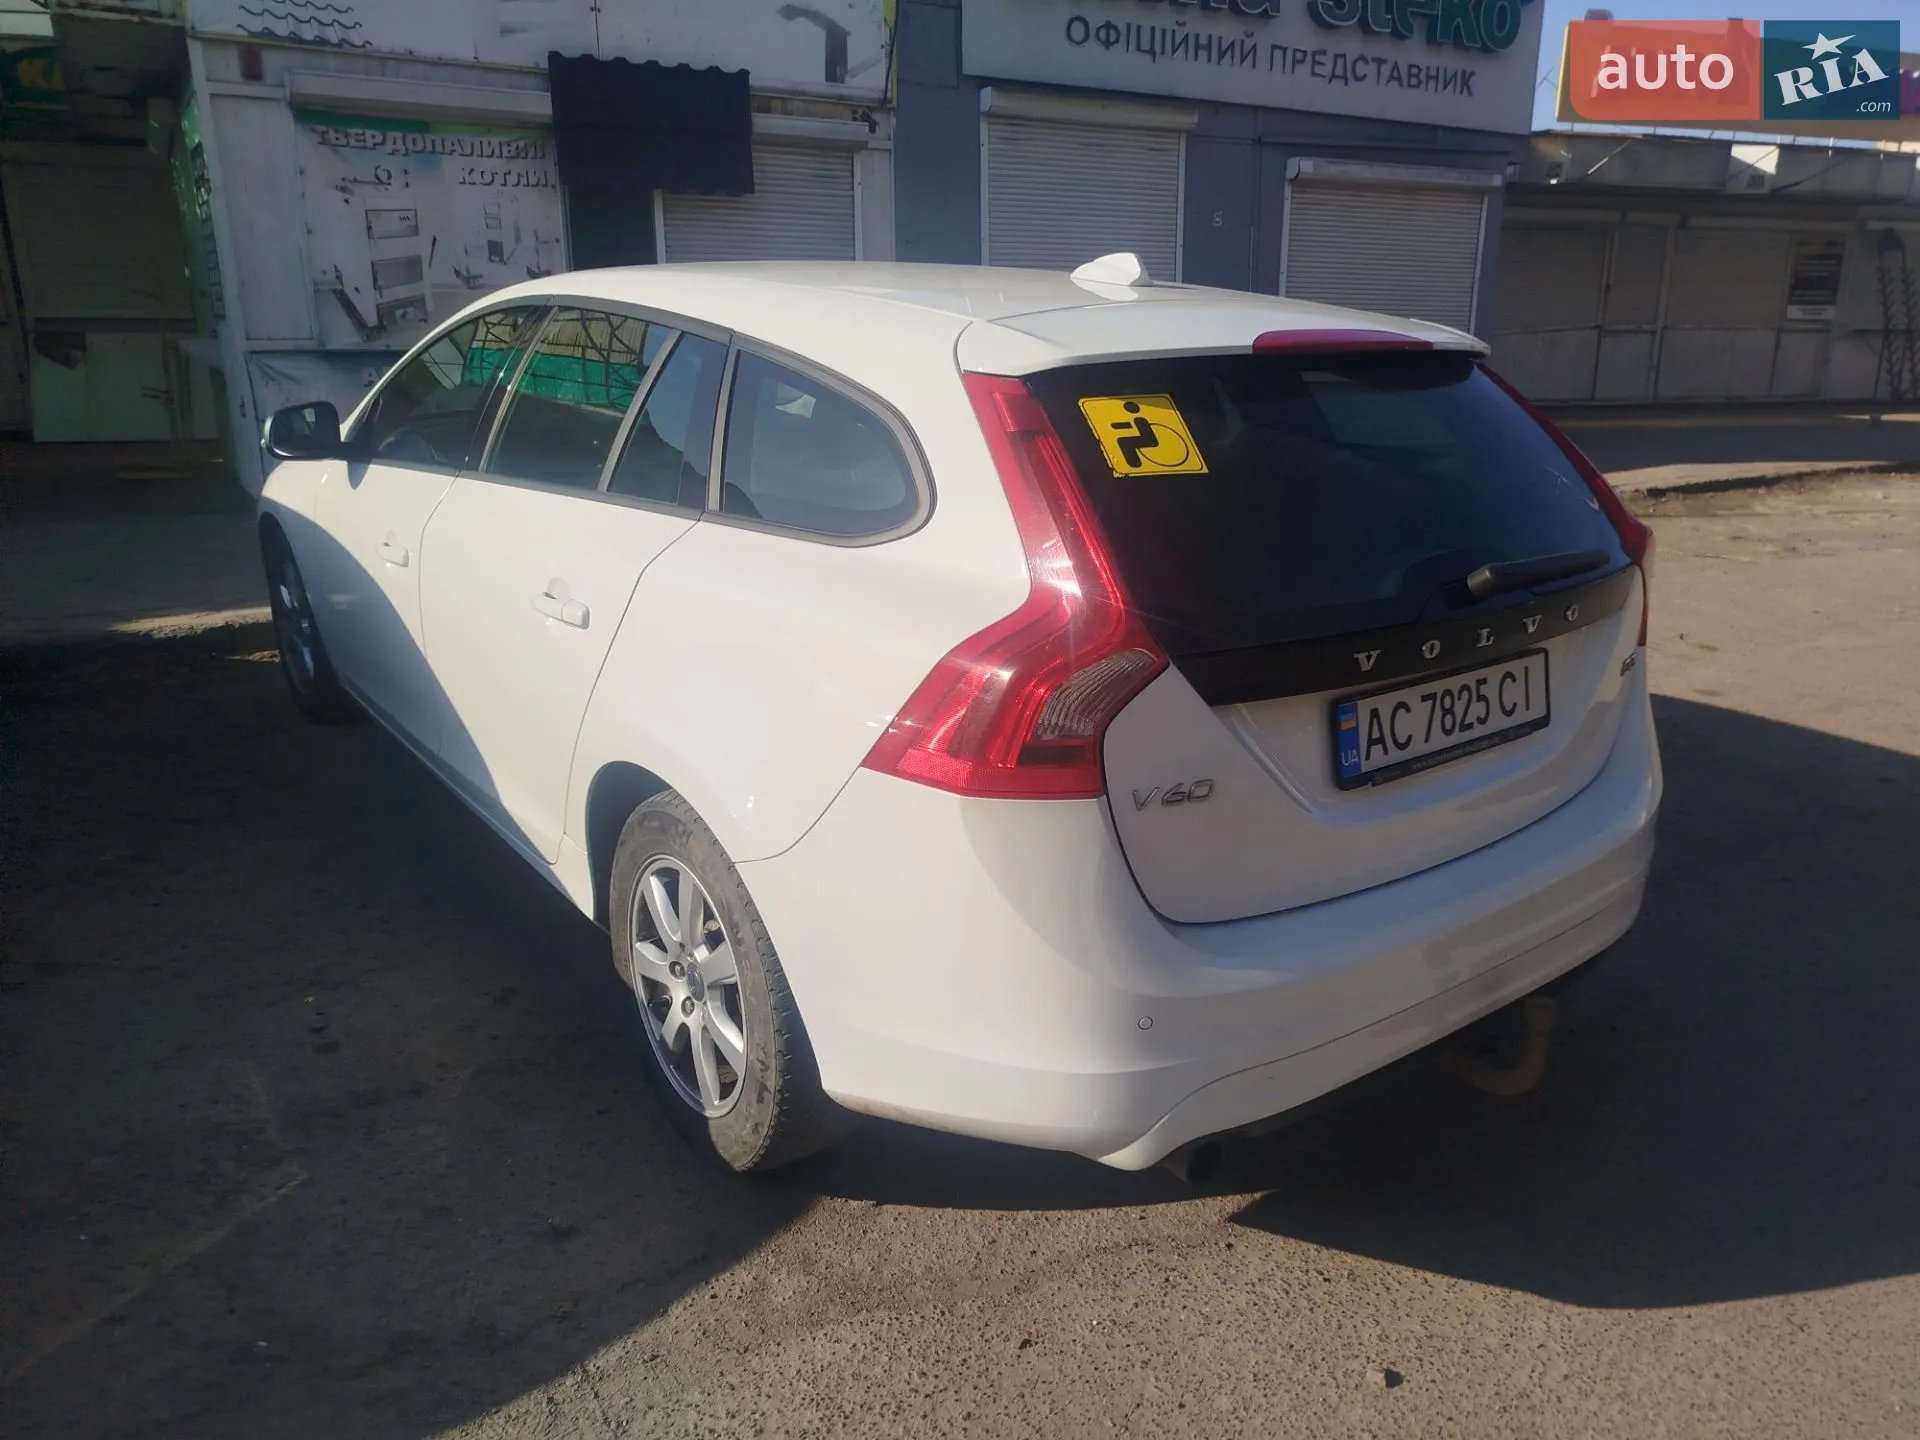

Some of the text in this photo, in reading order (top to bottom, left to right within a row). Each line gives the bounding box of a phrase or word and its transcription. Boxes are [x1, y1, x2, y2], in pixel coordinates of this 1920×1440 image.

[1066, 15, 1476, 97] ОФІЦІЙНИЙ ПРЕДСТАВНИК
[459, 167, 549, 188] КОТЛИ
[1354, 604, 1580, 672] VOLVO
[1364, 701, 1413, 761] AC
[1421, 678, 1490, 744] 7825
[1340, 750, 1360, 767] UA
[1131, 779, 1215, 812] V60
